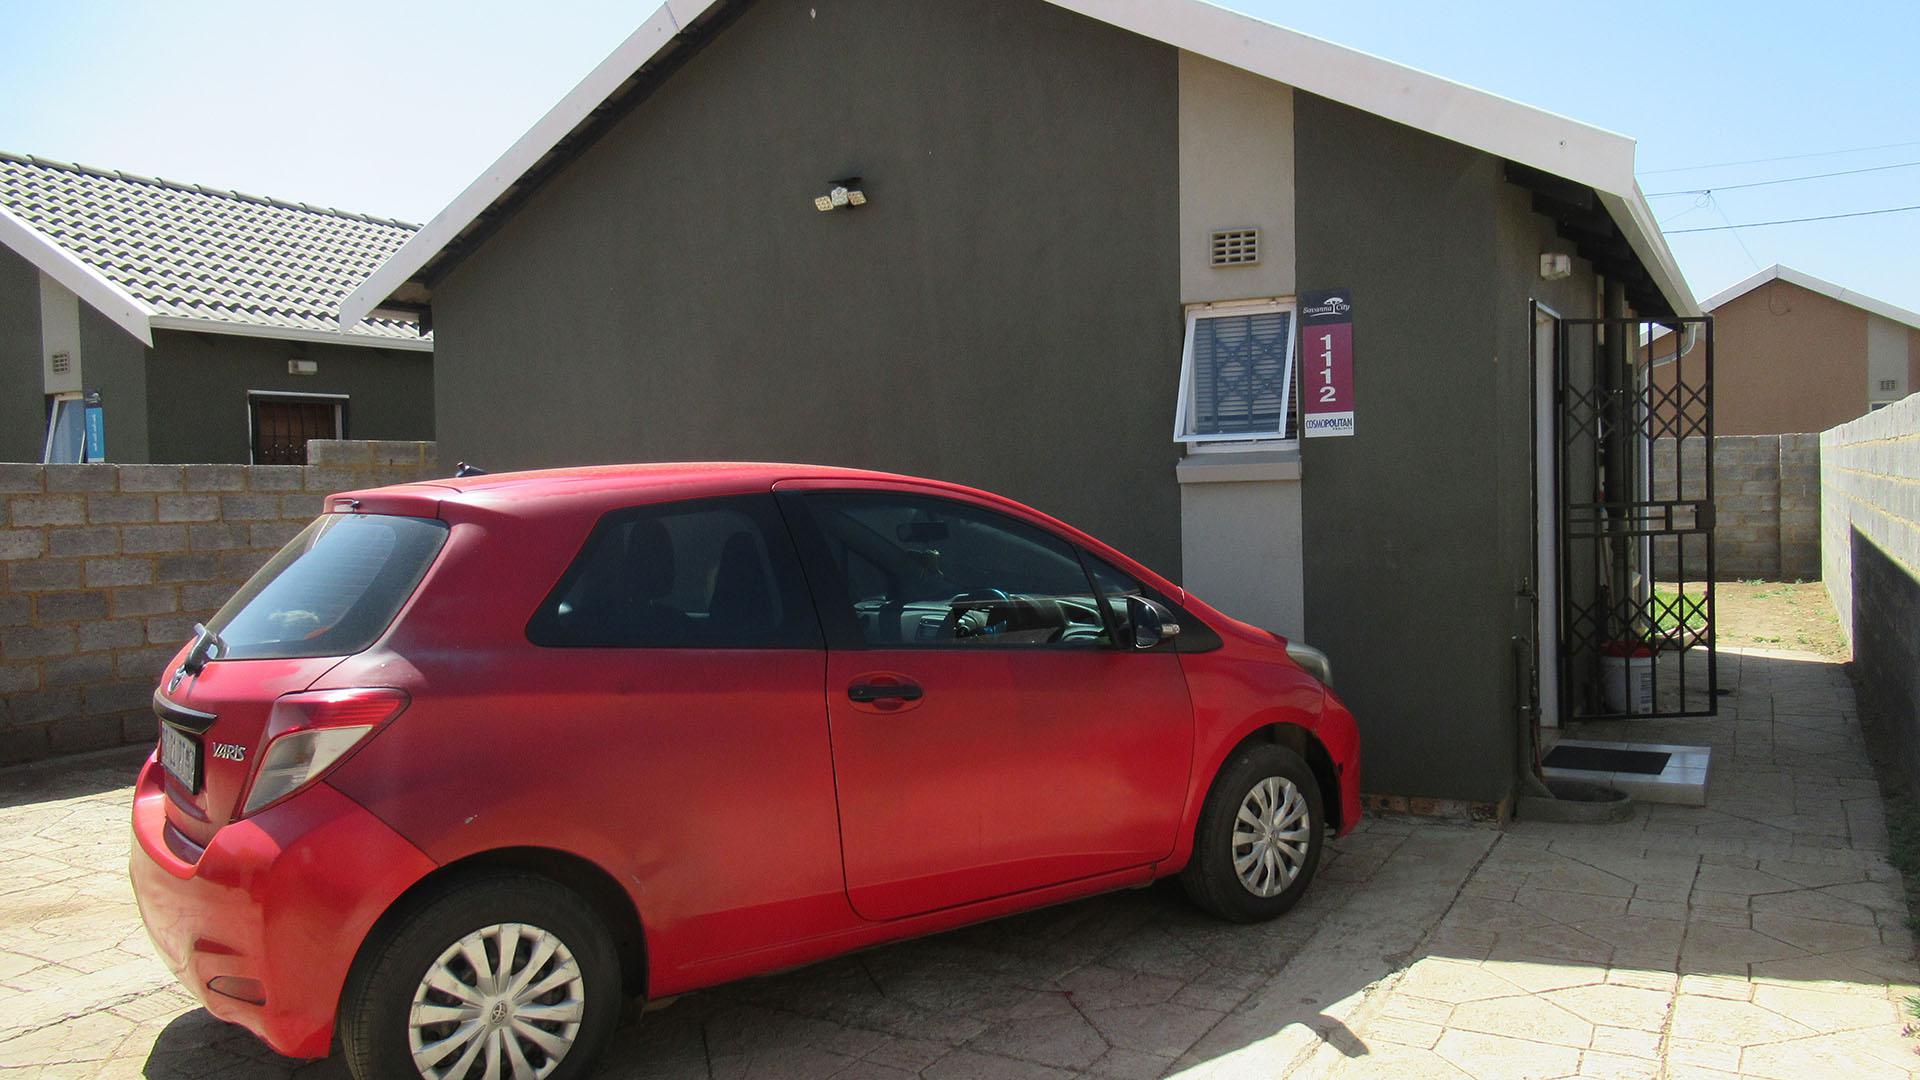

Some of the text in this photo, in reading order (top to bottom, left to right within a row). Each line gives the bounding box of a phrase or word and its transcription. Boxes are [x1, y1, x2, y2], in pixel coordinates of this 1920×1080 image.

[1336, 303, 1351, 311] City
[1319, 334, 1336, 402] 1112
[1305, 418, 1353, 429] COSMOPOLITAN
